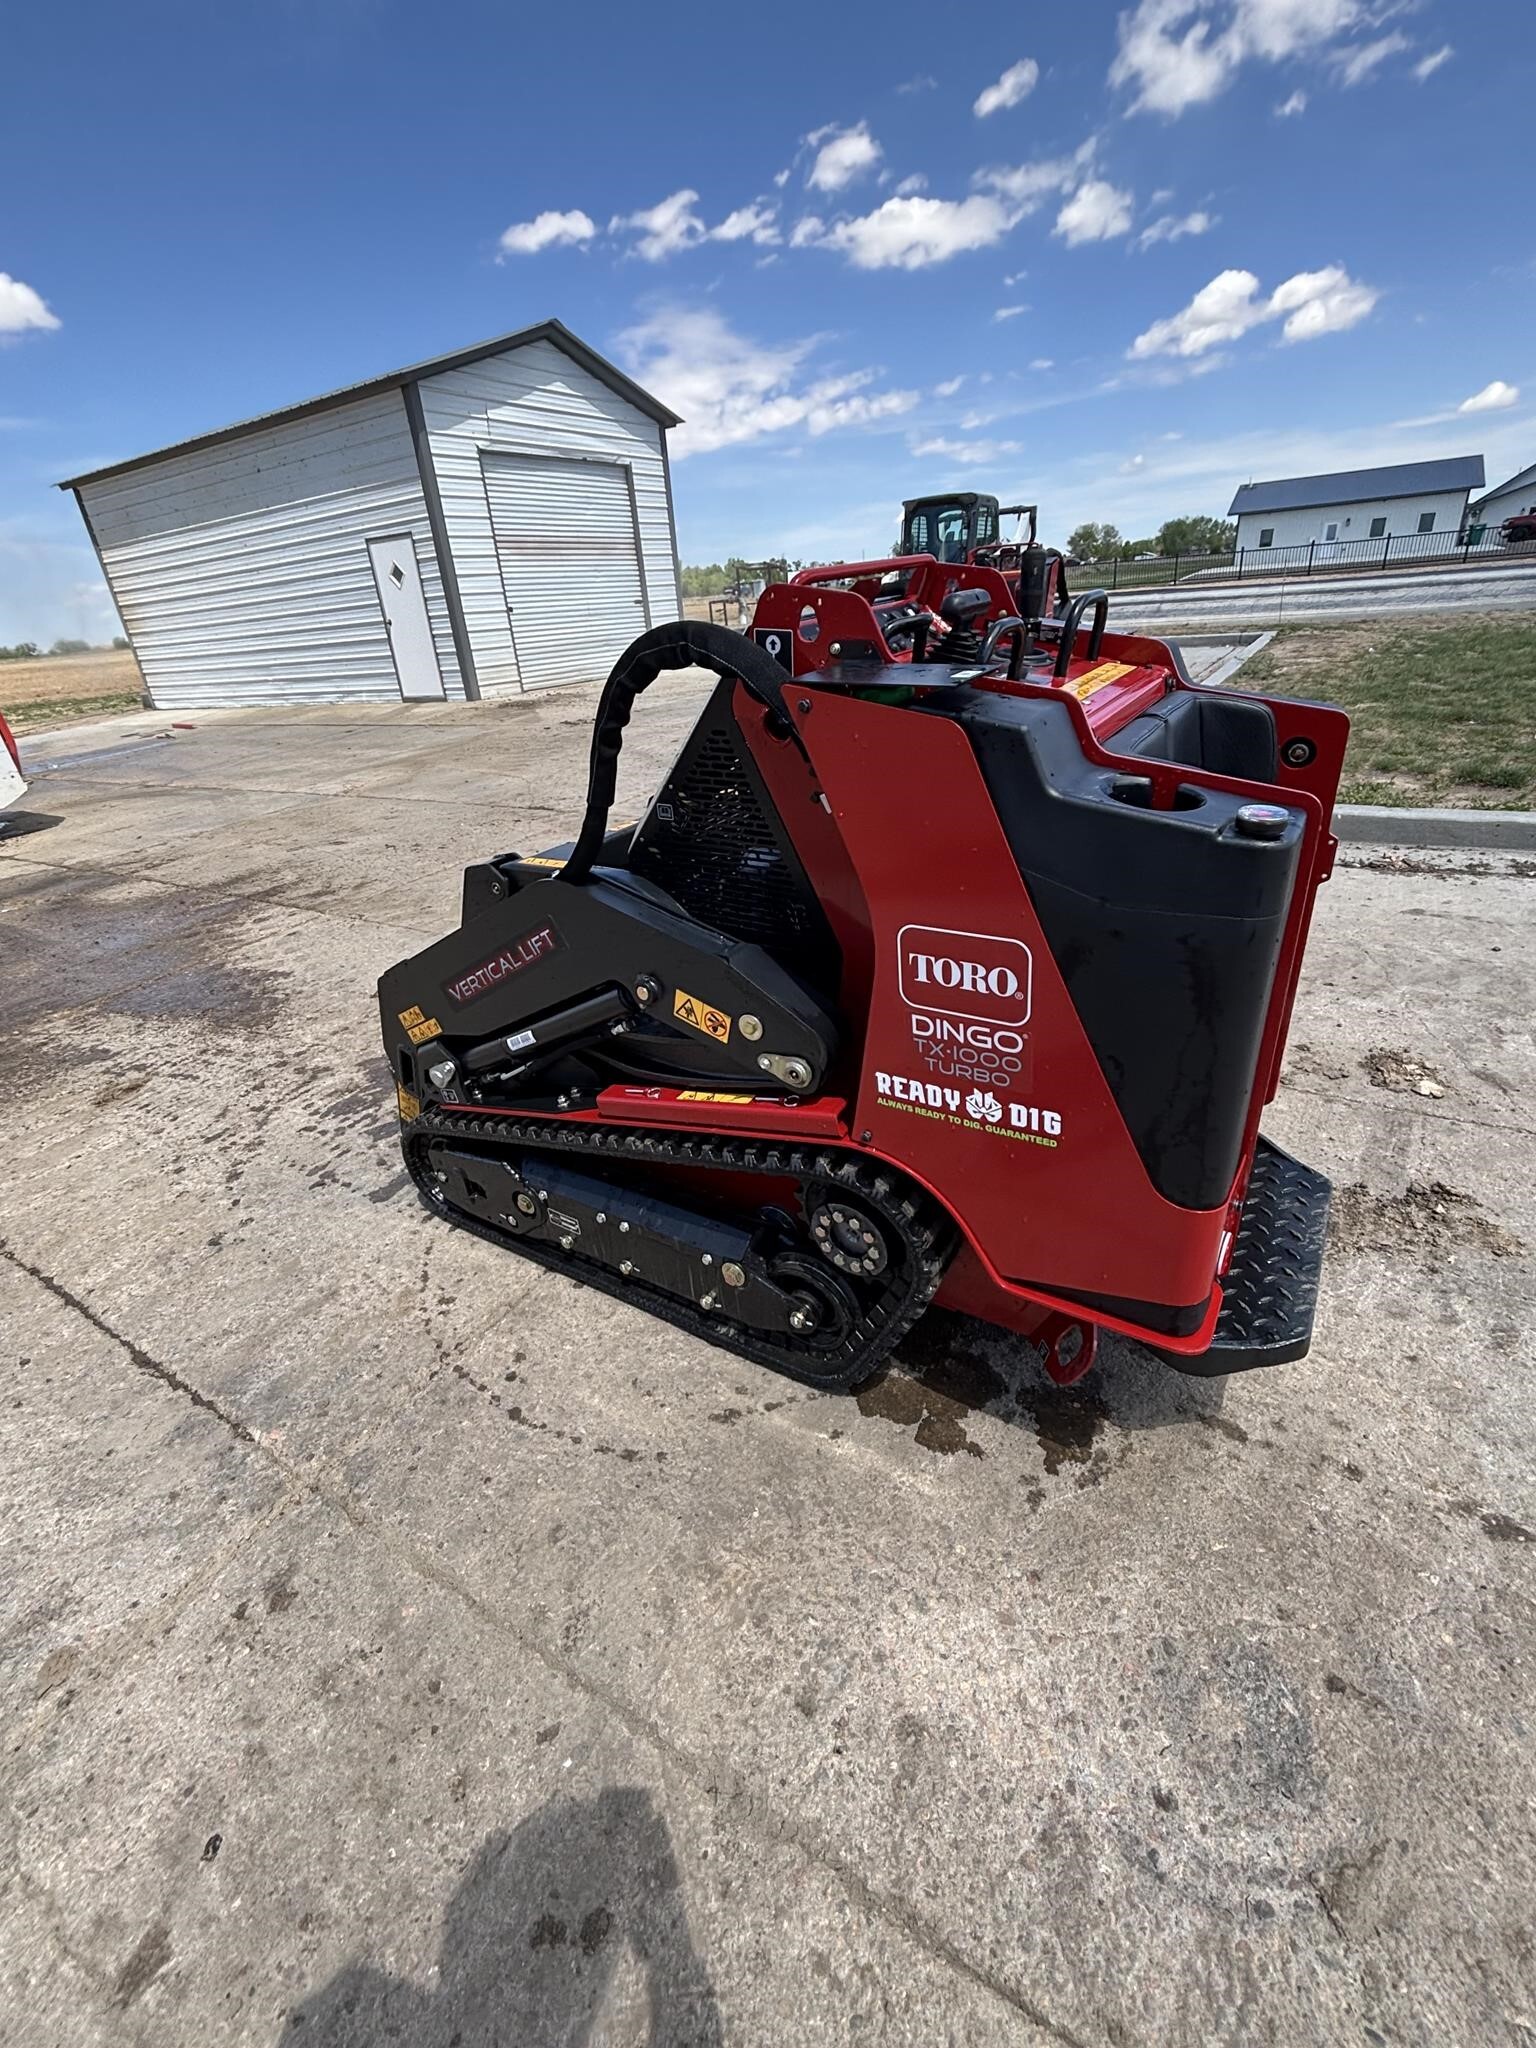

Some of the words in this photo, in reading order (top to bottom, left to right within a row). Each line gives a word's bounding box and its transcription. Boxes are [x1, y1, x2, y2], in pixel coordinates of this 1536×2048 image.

[448, 952, 522, 1000] VERTICAL
[518, 929, 553, 961] LIFT
[908, 953, 1019, 998] TORO
[911, 1014, 1023, 1053] DINGO
[924, 1057, 1010, 1086] TURBO
[875, 1072, 960, 1111] READY
[1008, 1103, 1062, 1135] DIG
[877, 1097, 914, 1112] ALWAYS
[914, 1107, 945, 1120] READY
[948, 1115, 961, 1125] TO
[963, 1119, 984, 1130] DIG.
[985, 1124, 1058, 1147] GUARANTEED
